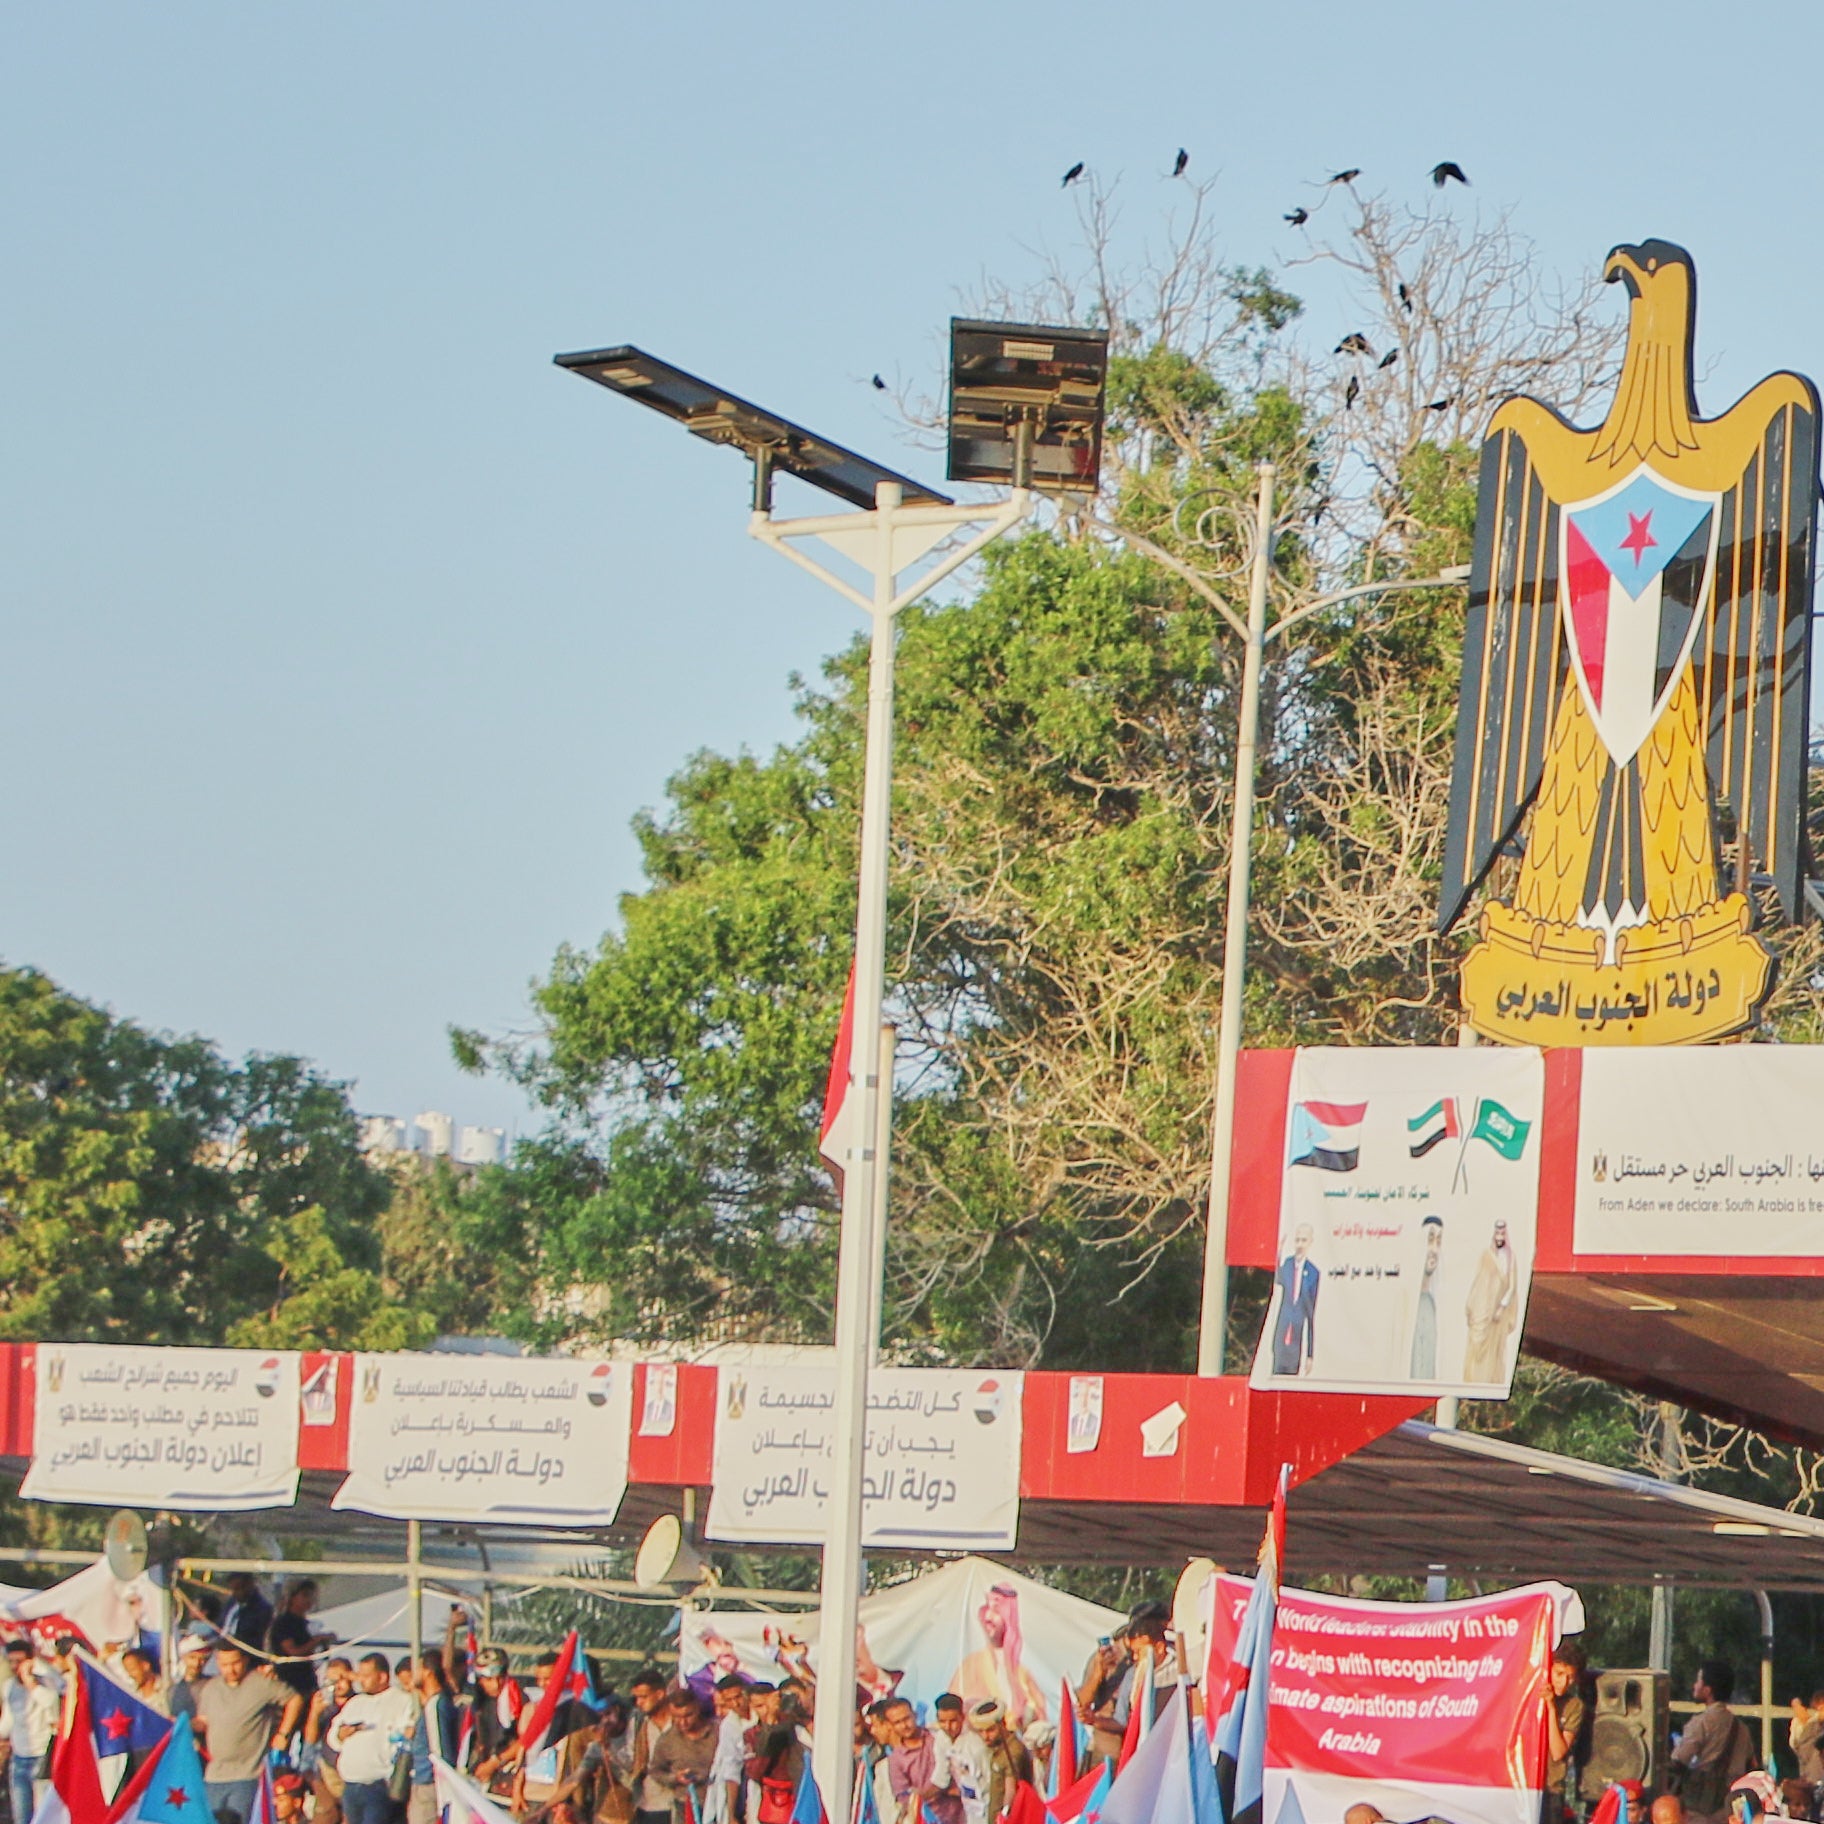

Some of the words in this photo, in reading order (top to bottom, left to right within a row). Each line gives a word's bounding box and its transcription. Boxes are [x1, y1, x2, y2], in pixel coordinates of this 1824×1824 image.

[1497, 980, 1571, 1021] العربي
[1575, 978, 1658, 1031] الجنوب
[1665, 968, 1720, 1015] دولة
[1614, 1154, 1665, 1182] مستقل
[1668, 1162, 1688, 1184] حر
[1628, 1197, 1654, 1212] Aden
[1677, 1198, 1722, 1212] declare:
[759, 1386, 835, 1416] لجسيمة
[924, 1390, 962, 1417] كل
[752, 1427, 824, 1458] بإعلان
[877, 1426, 895, 1457] أن
[897, 1438, 955, 1460] يجب
[211, 1442, 262, 1478] إعلان
[743, 1468, 808, 1516] العربي
[813, 1470, 895, 1510] الجب
[900, 1466, 956, 1512] دولة
[1277, 1606, 1321, 1631] World
[1286, 1646, 1334, 1677] begins
[1337, 1653, 1372, 1675] with
[1374, 1655, 1478, 1684] recognizing
[1321, 1694, 1416, 1718] aspirations
[1435, 1695, 1479, 1717] South
[1318, 1728, 1381, 1756] Arabia
